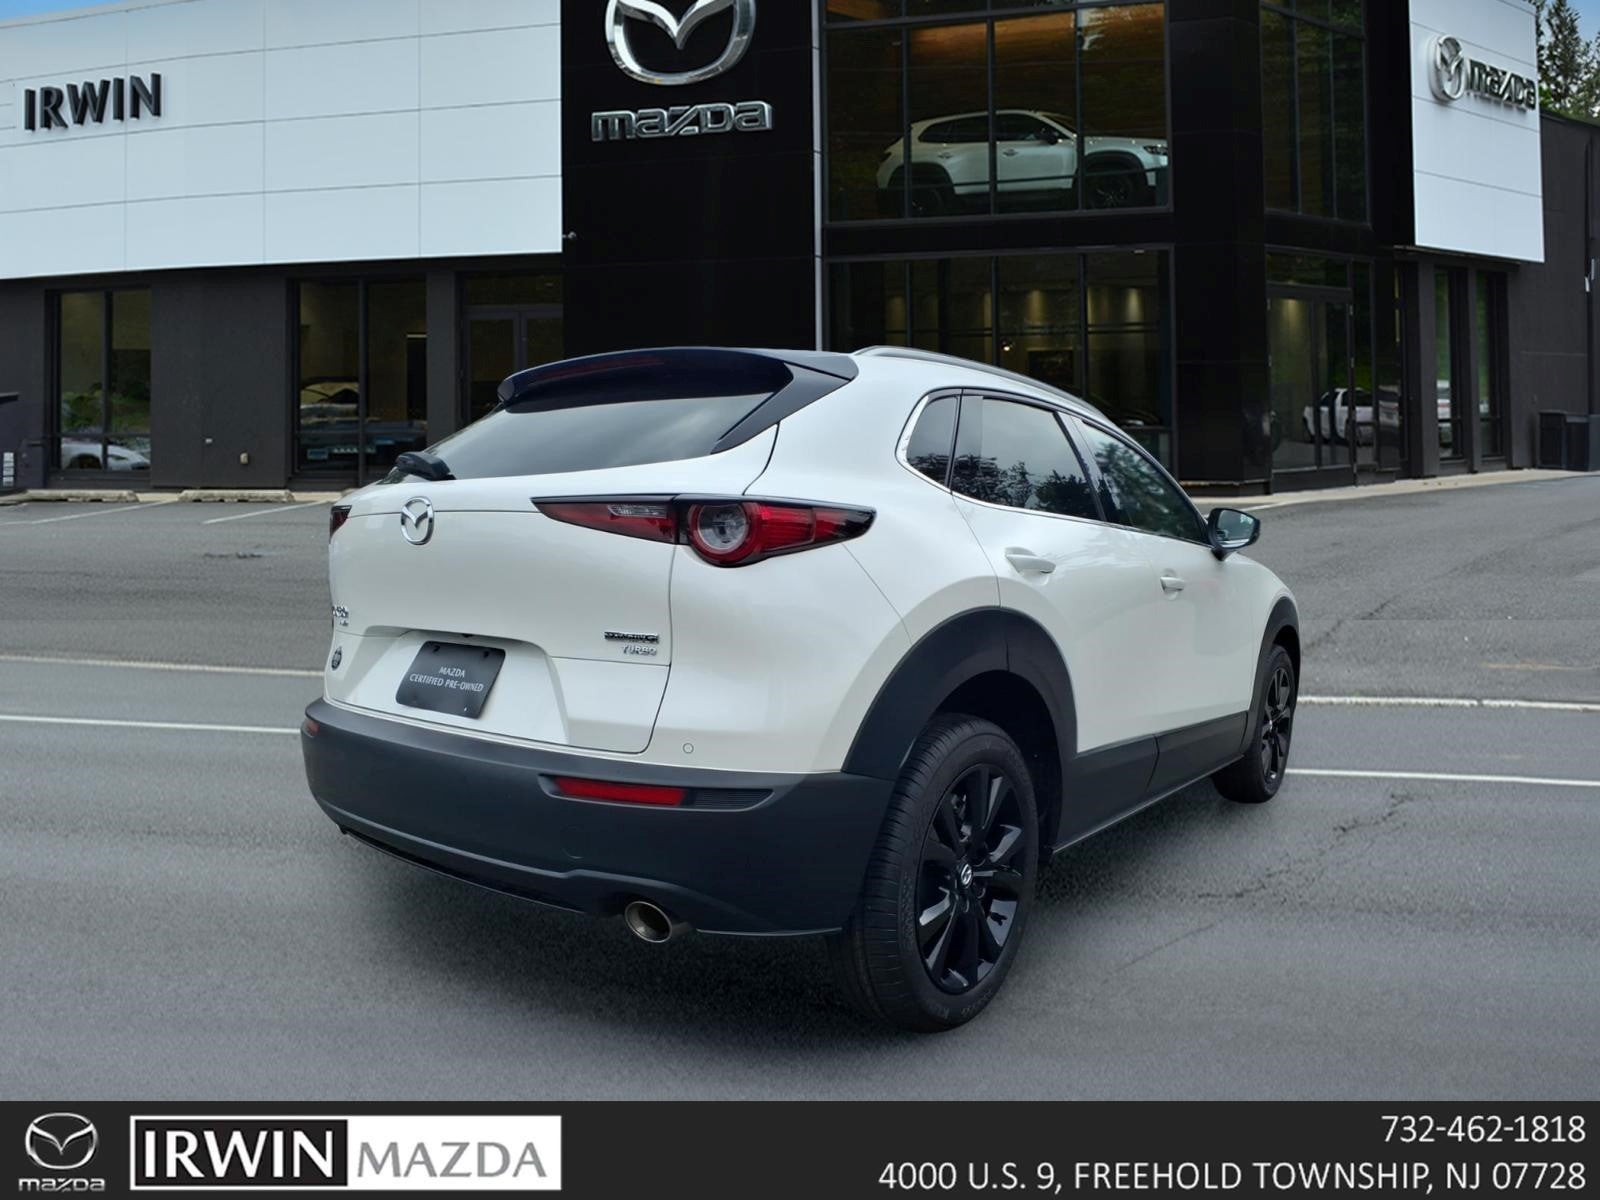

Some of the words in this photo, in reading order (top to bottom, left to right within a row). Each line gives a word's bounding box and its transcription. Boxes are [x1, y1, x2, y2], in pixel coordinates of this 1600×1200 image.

[24, 72, 162, 131] IRWIN
[439, 666, 466, 678] MAZDA
[409, 673, 444, 687] CERTIFIED
[445, 680, 485, 692] PRE-OWNED
